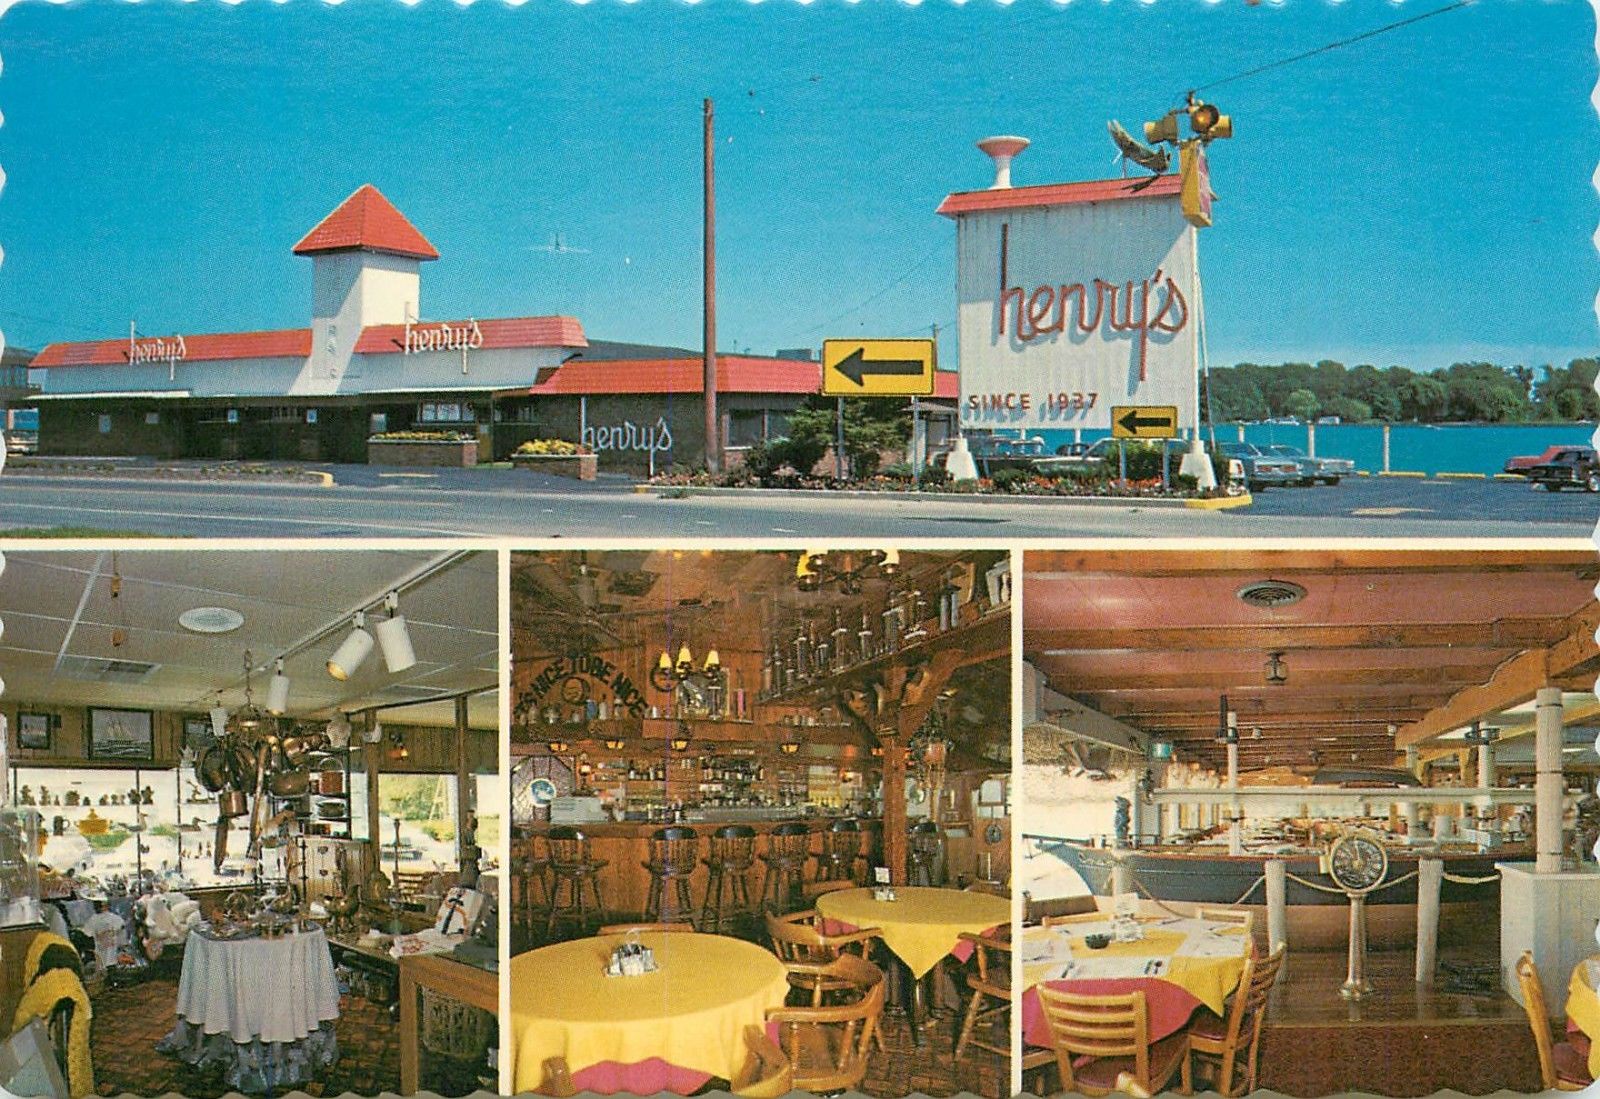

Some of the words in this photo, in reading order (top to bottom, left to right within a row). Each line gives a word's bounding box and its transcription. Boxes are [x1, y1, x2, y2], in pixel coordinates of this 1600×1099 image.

[403, 302, 483, 374] henry's
[1000, 224, 1188, 381] henry's
[580, 397, 672, 477] henry's
[968, 393, 1031, 410] SINCE
[1047, 392, 1099, 410] 1937
[529, 655, 570, 700] NICE
[566, 648, 589, 674] TO
[589, 656, 617, 685] BE
[611, 672, 649, 719] NICE
